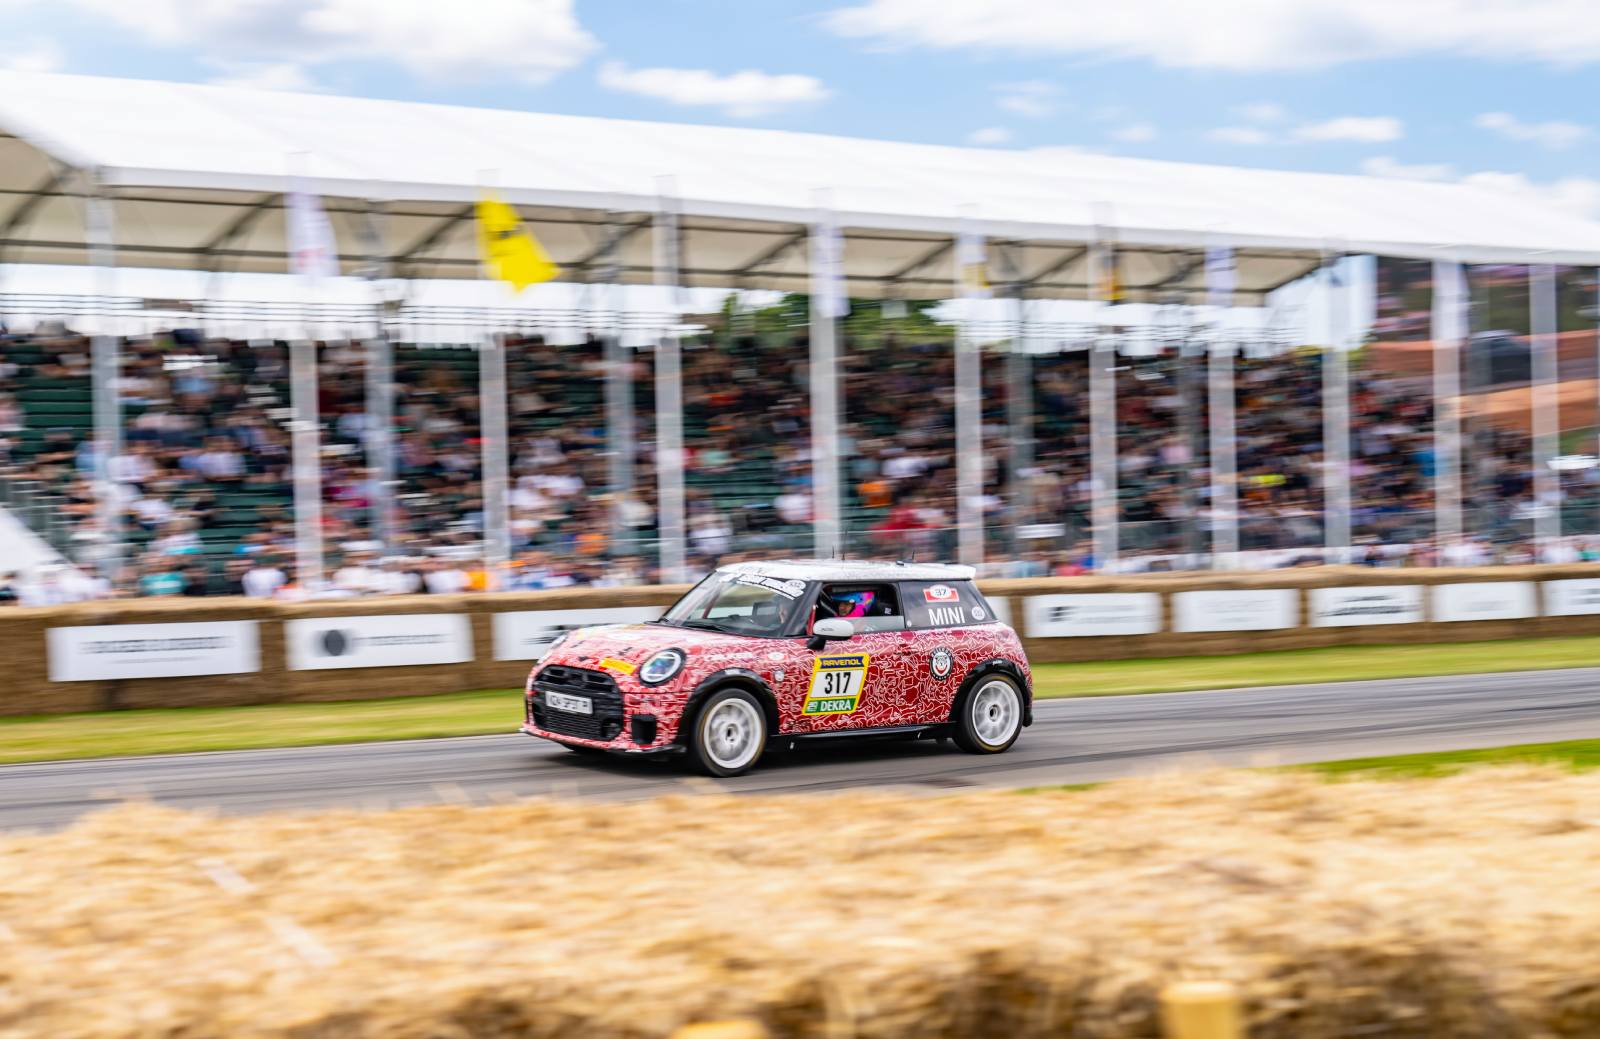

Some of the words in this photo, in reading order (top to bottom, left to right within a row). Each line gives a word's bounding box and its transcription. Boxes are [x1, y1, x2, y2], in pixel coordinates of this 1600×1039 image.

[928, 606, 966, 626] MINI
[823, 658, 862, 667] RAVENOL
[824, 671, 851, 695] 317
[820, 699, 852, 712] DEKRA
